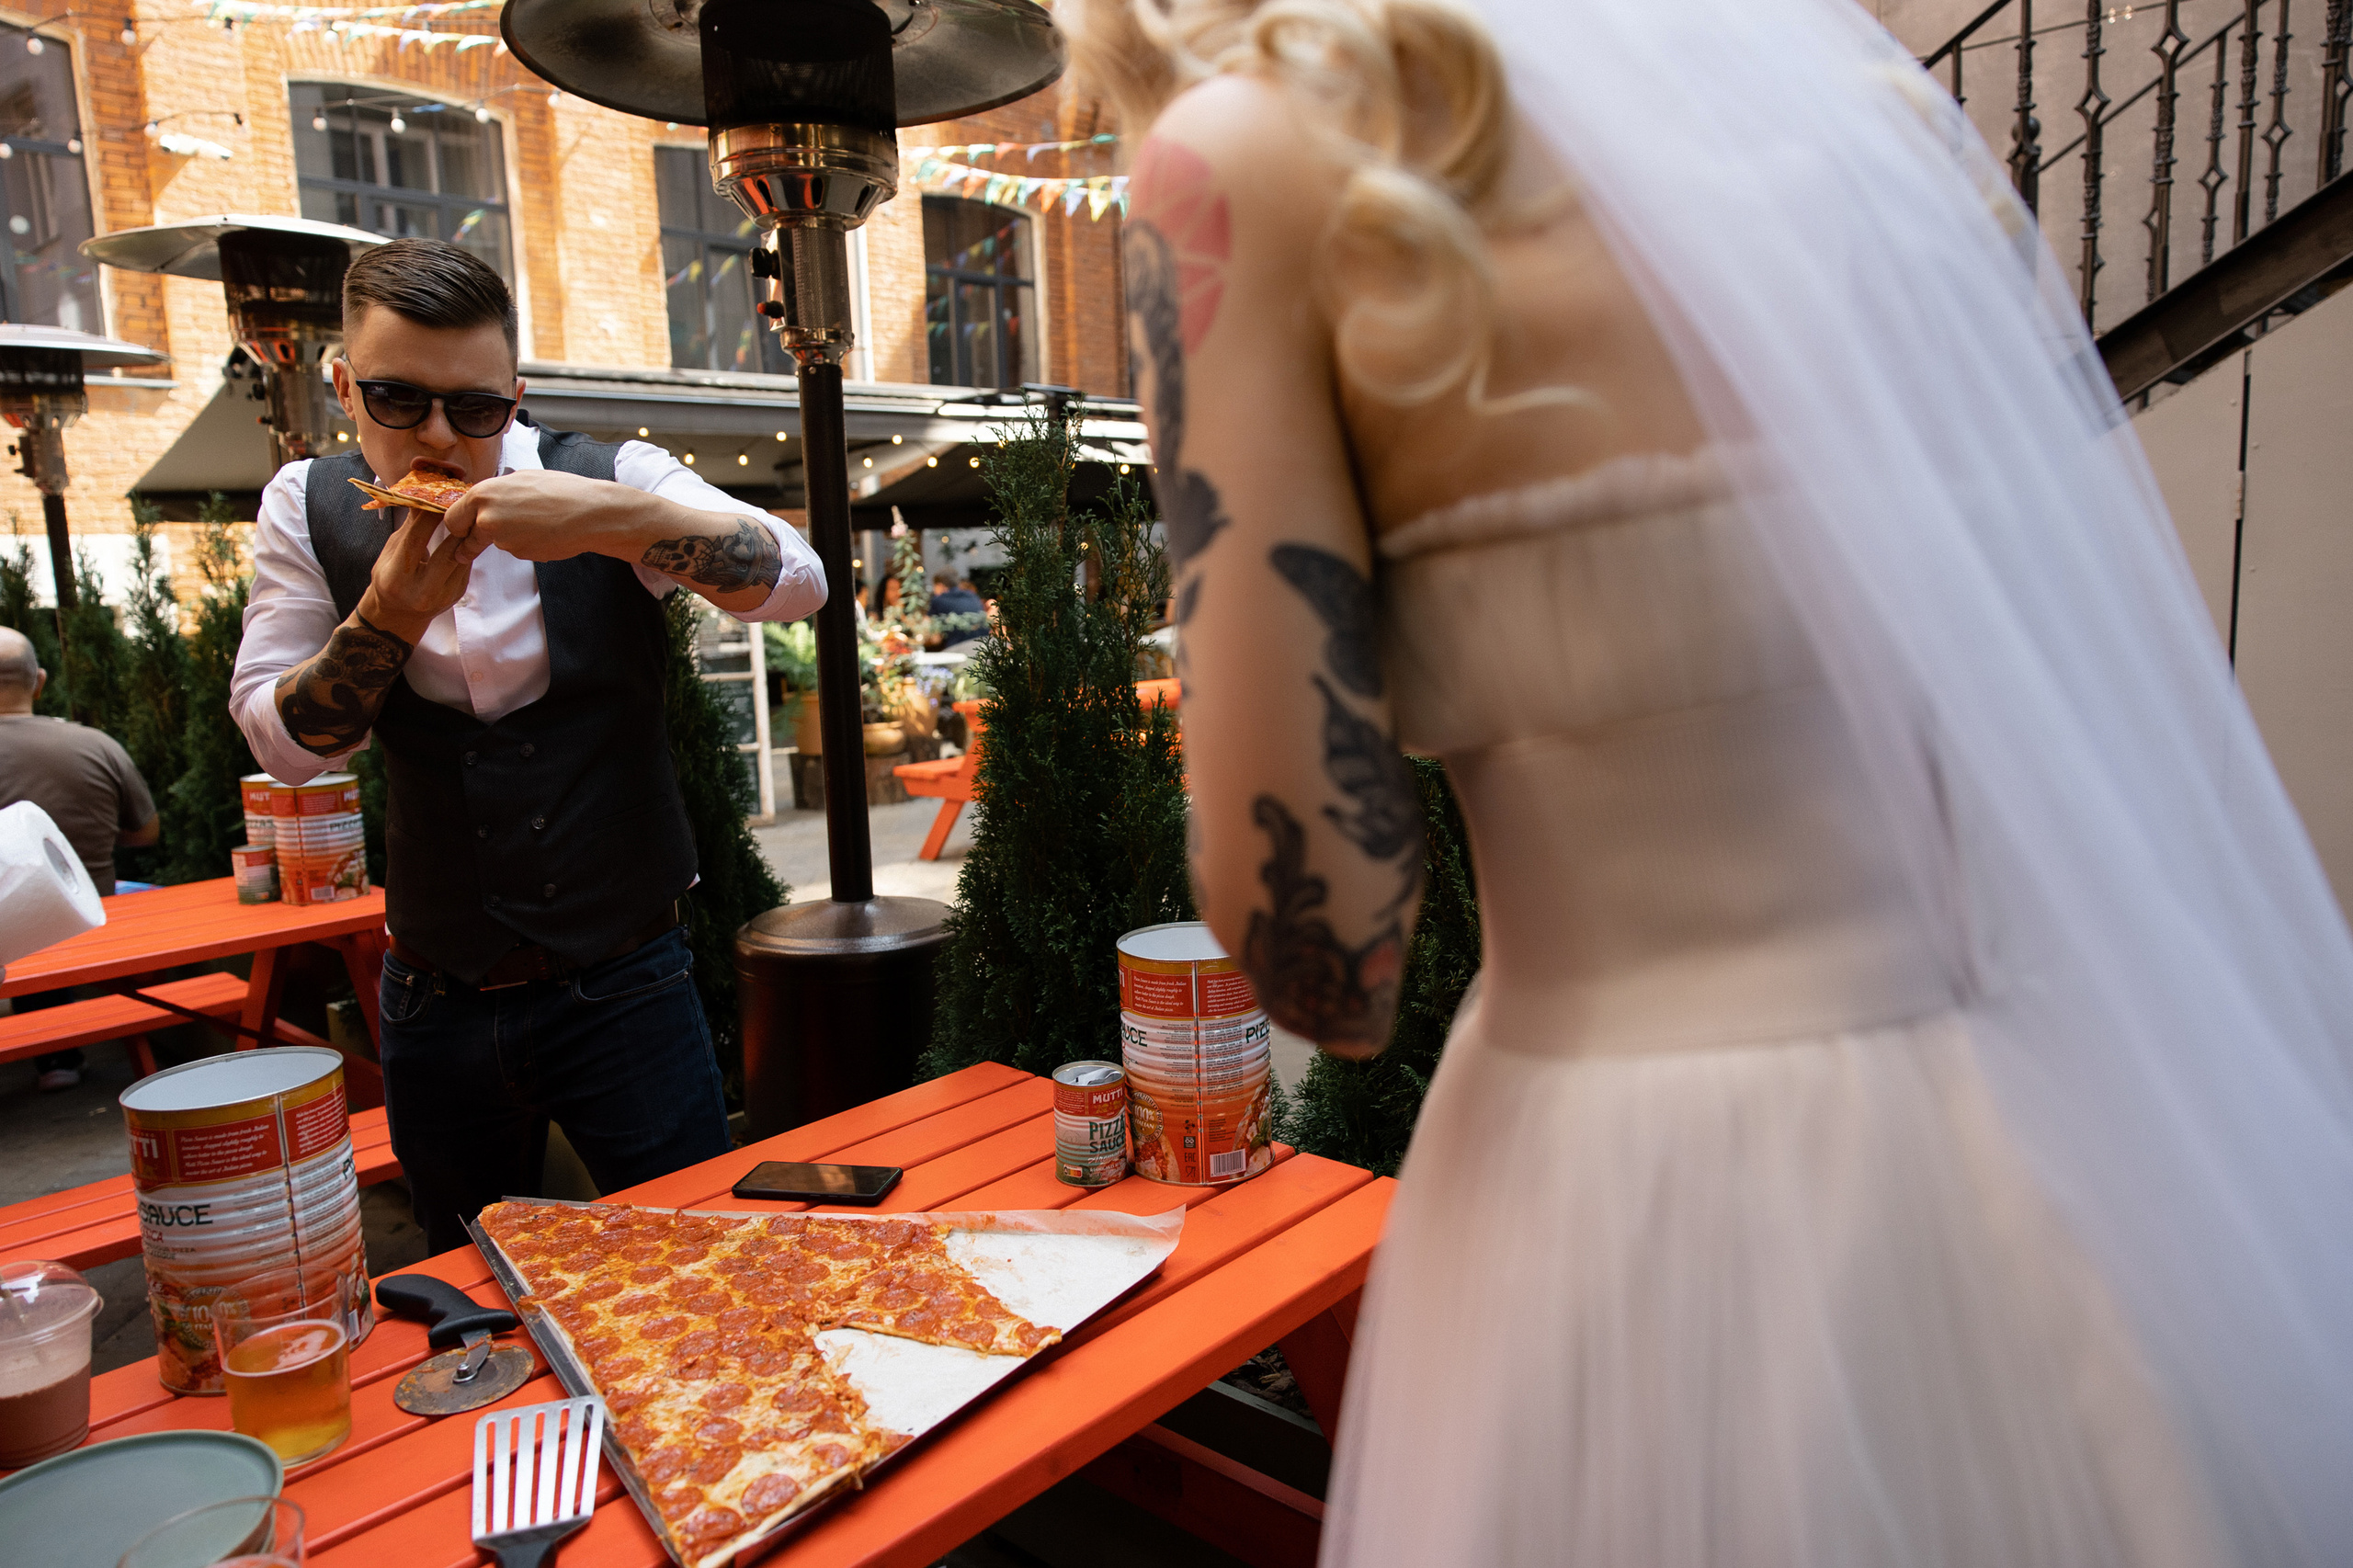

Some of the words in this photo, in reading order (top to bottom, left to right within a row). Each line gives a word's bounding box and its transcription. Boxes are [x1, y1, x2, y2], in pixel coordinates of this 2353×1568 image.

[250, 791, 270, 801] MUT
[1093, 1087, 1122, 1104] MUTTI
[1134, 1105, 1154, 1121] 100%
[1089, 1114, 1125, 1141] PIZZA
[1089, 1131, 1125, 1153] SAUCE
[140, 1201, 213, 1227] SAUCE
